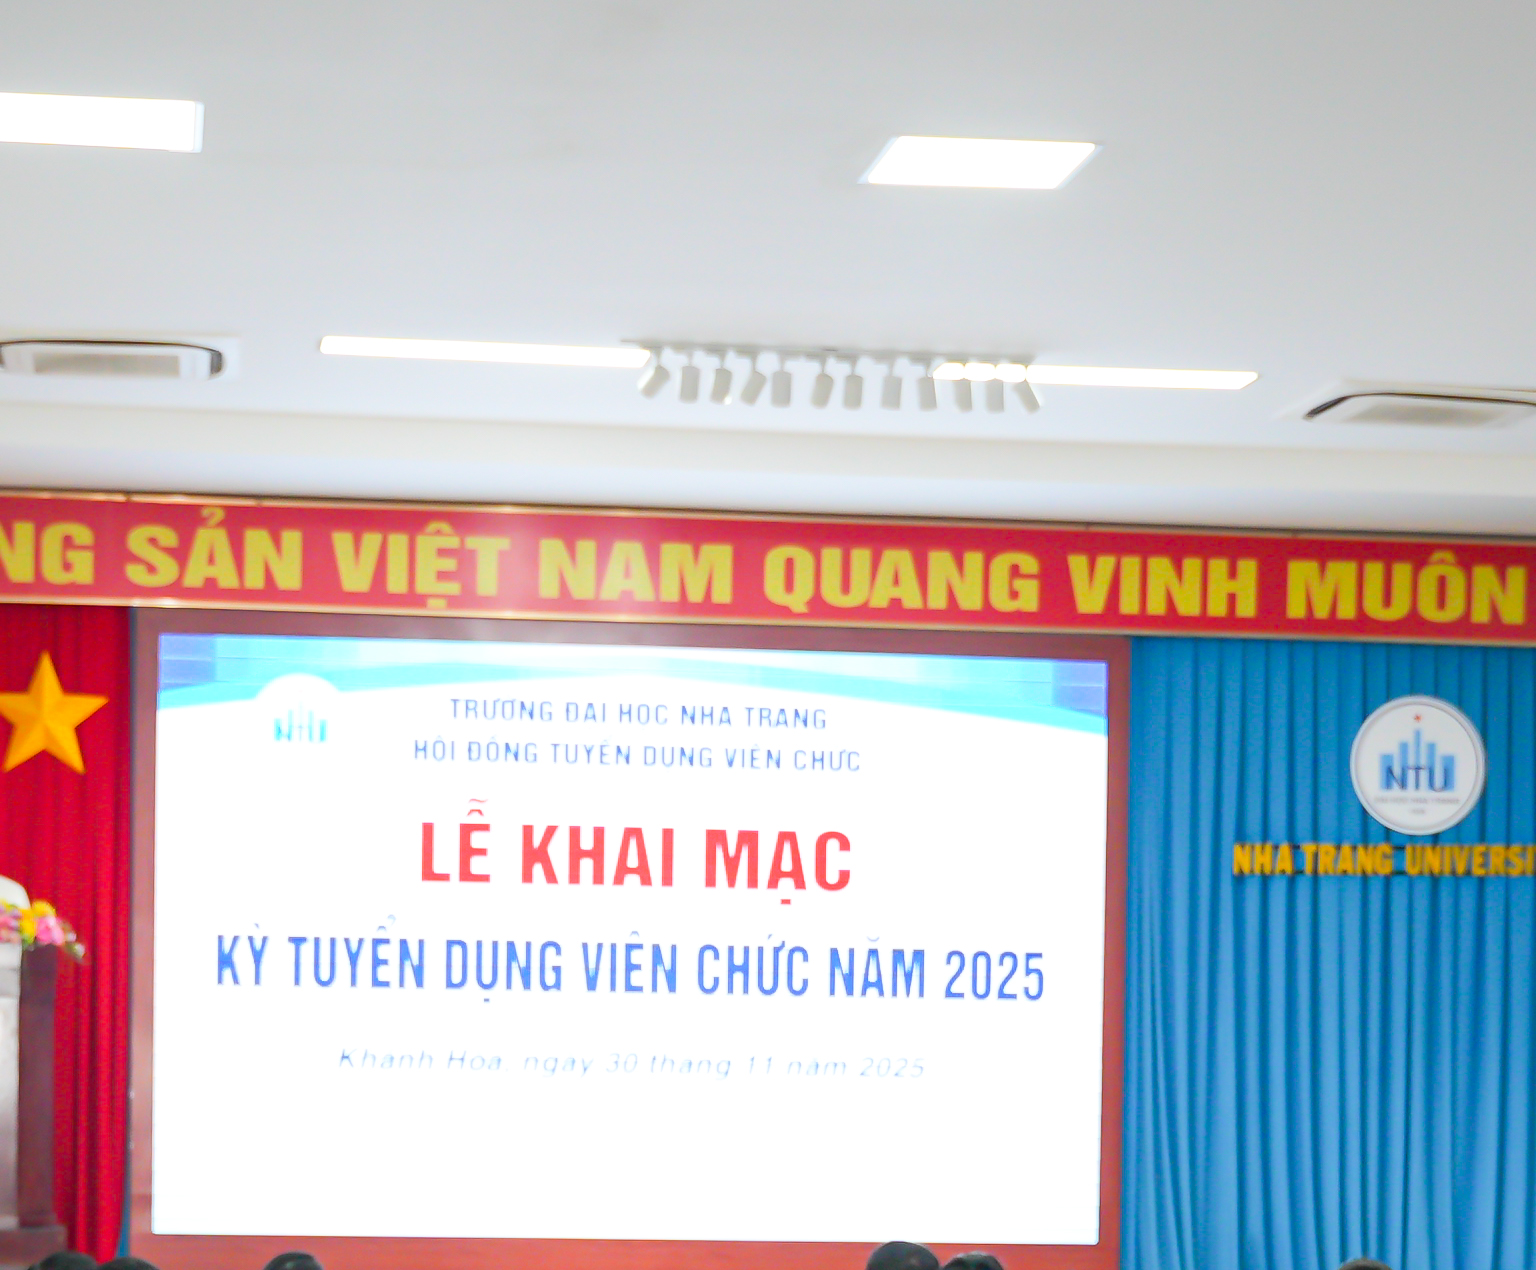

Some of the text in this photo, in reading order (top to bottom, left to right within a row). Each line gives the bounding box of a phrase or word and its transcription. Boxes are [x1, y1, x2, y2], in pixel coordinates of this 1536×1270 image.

[123, 509, 303, 591] SẢN
[331, 521, 510, 610] VIỆT
[536, 539, 728, 607] NAM
[762, 542, 1041, 614] QUANG
[1066, 552, 1259, 620] VINH
[1286, 548, 1527, 624] MUÔN
[680, 705, 828, 731] NHA TRANG
[421, 798, 852, 905] LỄ KHAI MẠC
[1232, 842, 1294, 876] NHA
[1301, 843, 1394, 876] TRANG
[216, 913, 1045, 1003] KỲ TUYỂN DỤNG VIÊN CHỨC NĂM 2025
[606, 1052, 926, 1080] 30 11 2025
